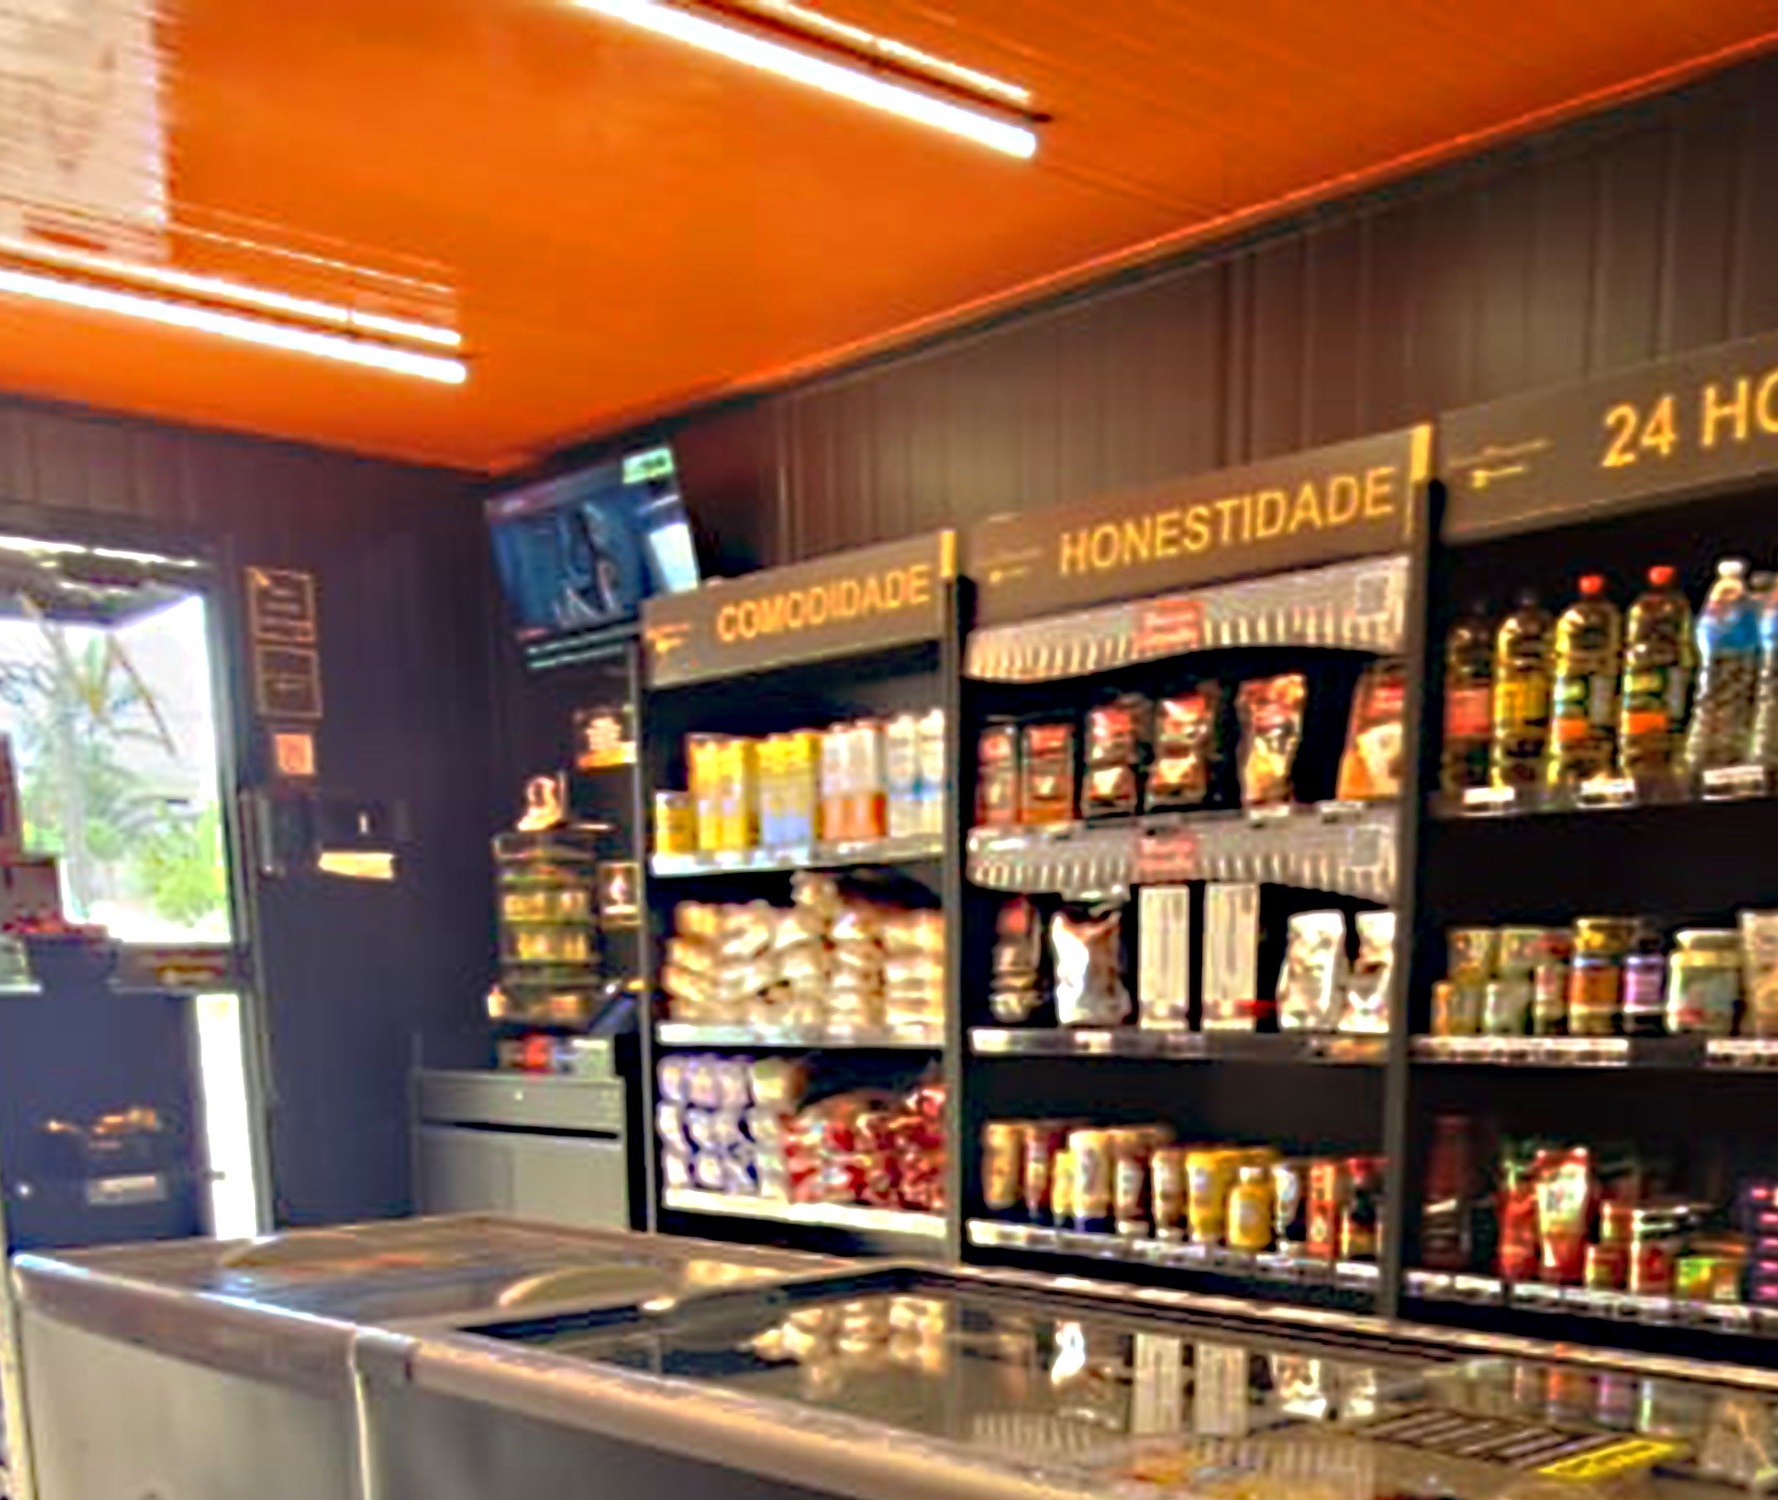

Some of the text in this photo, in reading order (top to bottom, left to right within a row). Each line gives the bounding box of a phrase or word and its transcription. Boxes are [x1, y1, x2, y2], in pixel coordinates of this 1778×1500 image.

[1601, 394, 1677, 468] 24
[1059, 466, 1398, 574] HONESTIDADE
[716, 563, 933, 643] COMODIDADE
